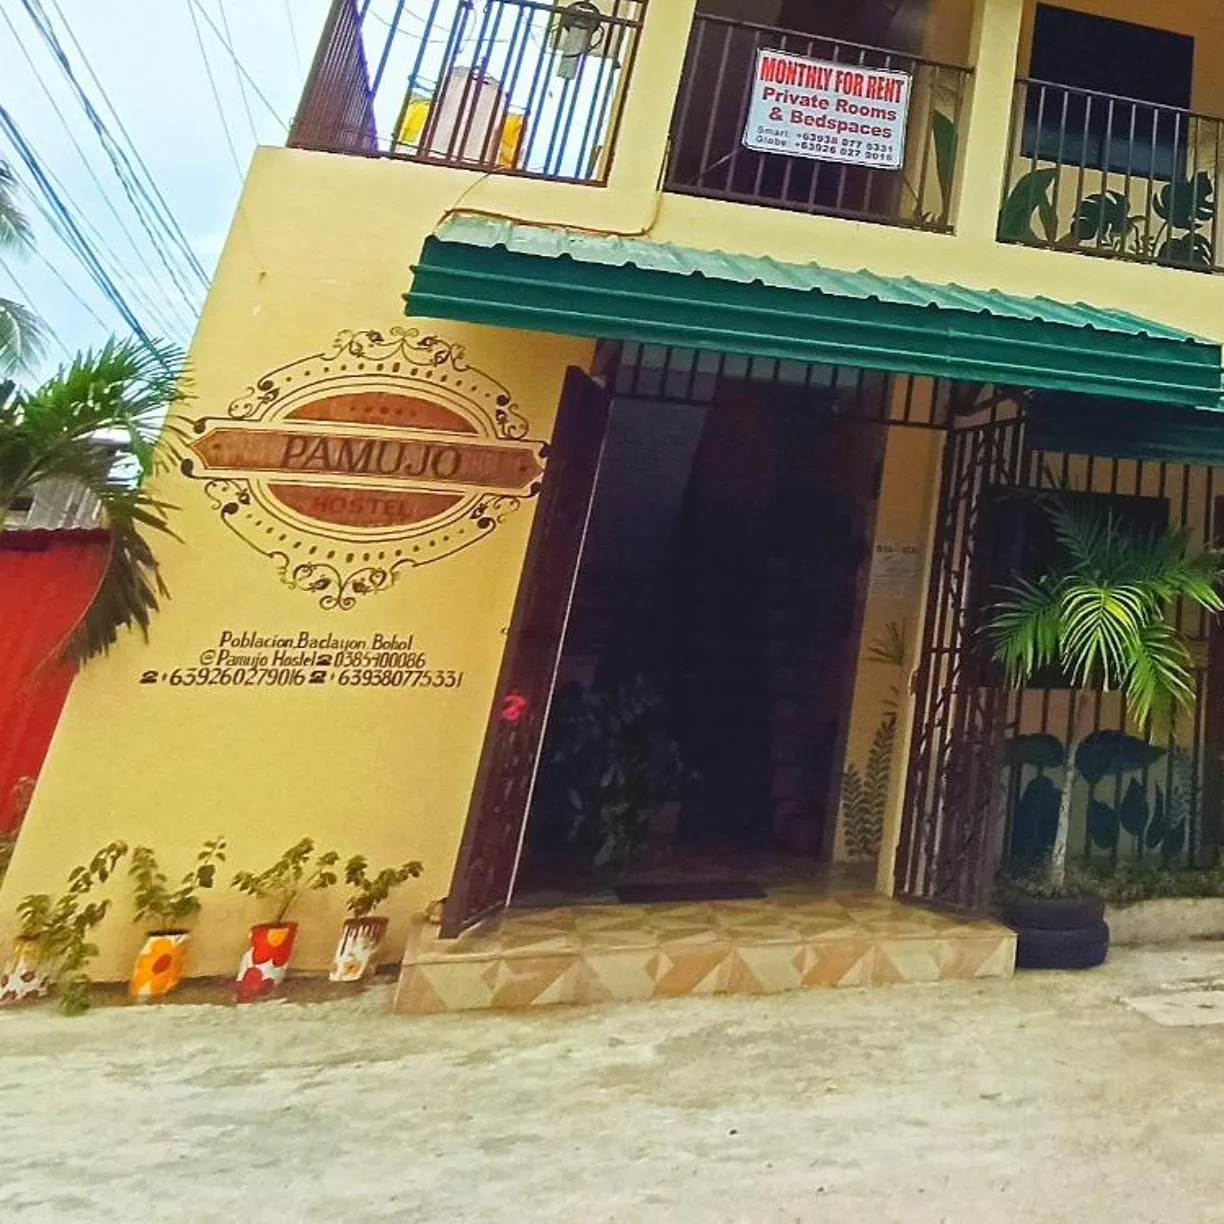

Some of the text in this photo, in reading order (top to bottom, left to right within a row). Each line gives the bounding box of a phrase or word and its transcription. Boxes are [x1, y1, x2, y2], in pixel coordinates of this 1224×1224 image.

[760, 57, 905, 104] MONTHLY FOR RENT
[763, 87, 897, 121] Private Rooms
[769, 107, 893, 139] & Bedspaces
[280, 437, 461, 477] PAMUJO
[313, 495, 414, 518] HOSTEL
[272, 650, 317, 667] Hostel
